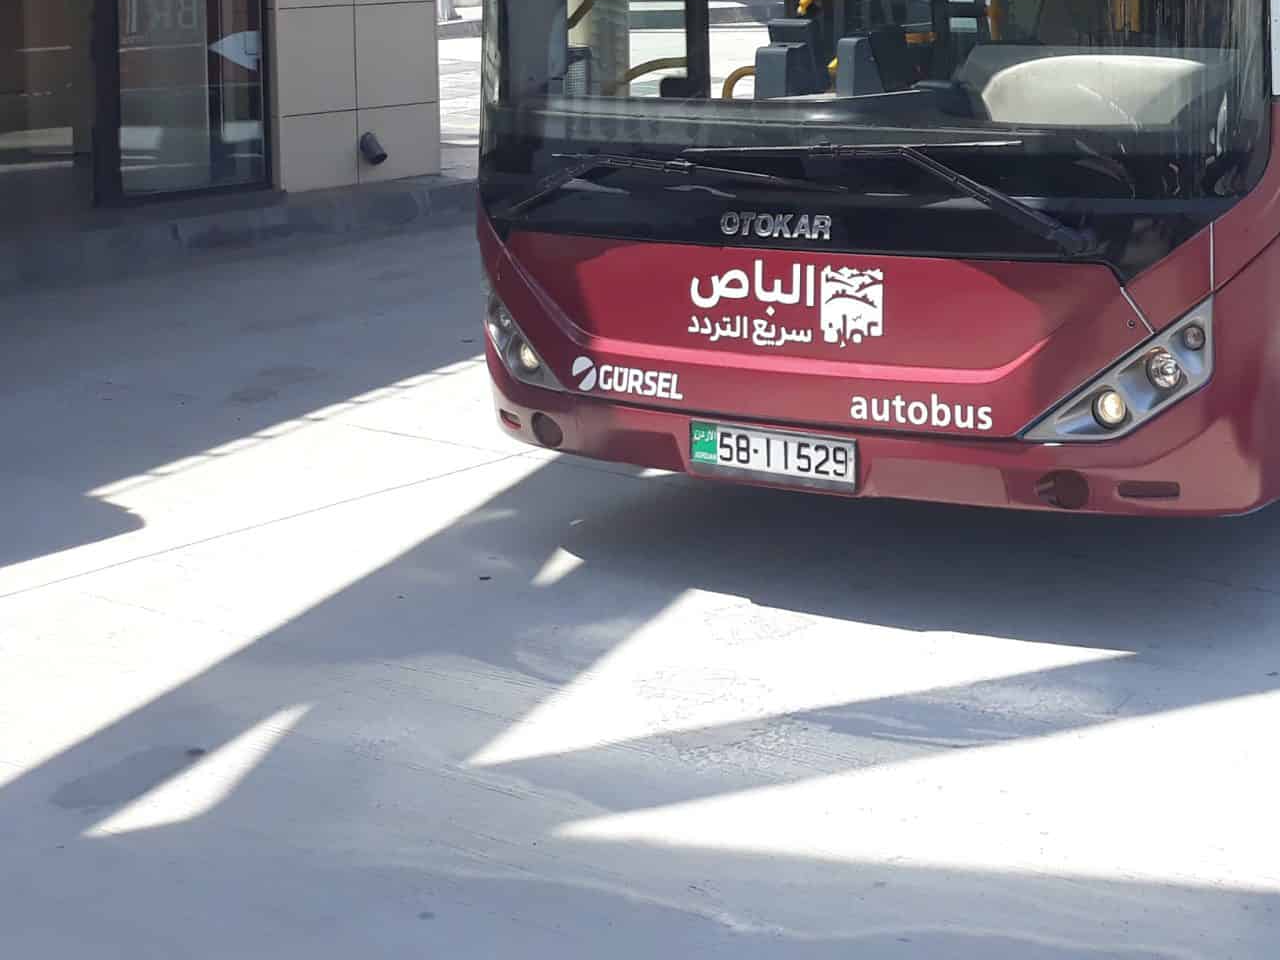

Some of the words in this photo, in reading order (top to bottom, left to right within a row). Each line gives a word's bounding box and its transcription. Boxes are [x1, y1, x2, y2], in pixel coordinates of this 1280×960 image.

[720, 211, 832, 240] OTOKAR
[690, 259, 815, 315] الباص
[687, 314, 748, 341] التردد
[752, 319, 812, 347] سريع
[599, 364, 683, 400] GÜRSEL
[850, 393, 993, 430] autobus
